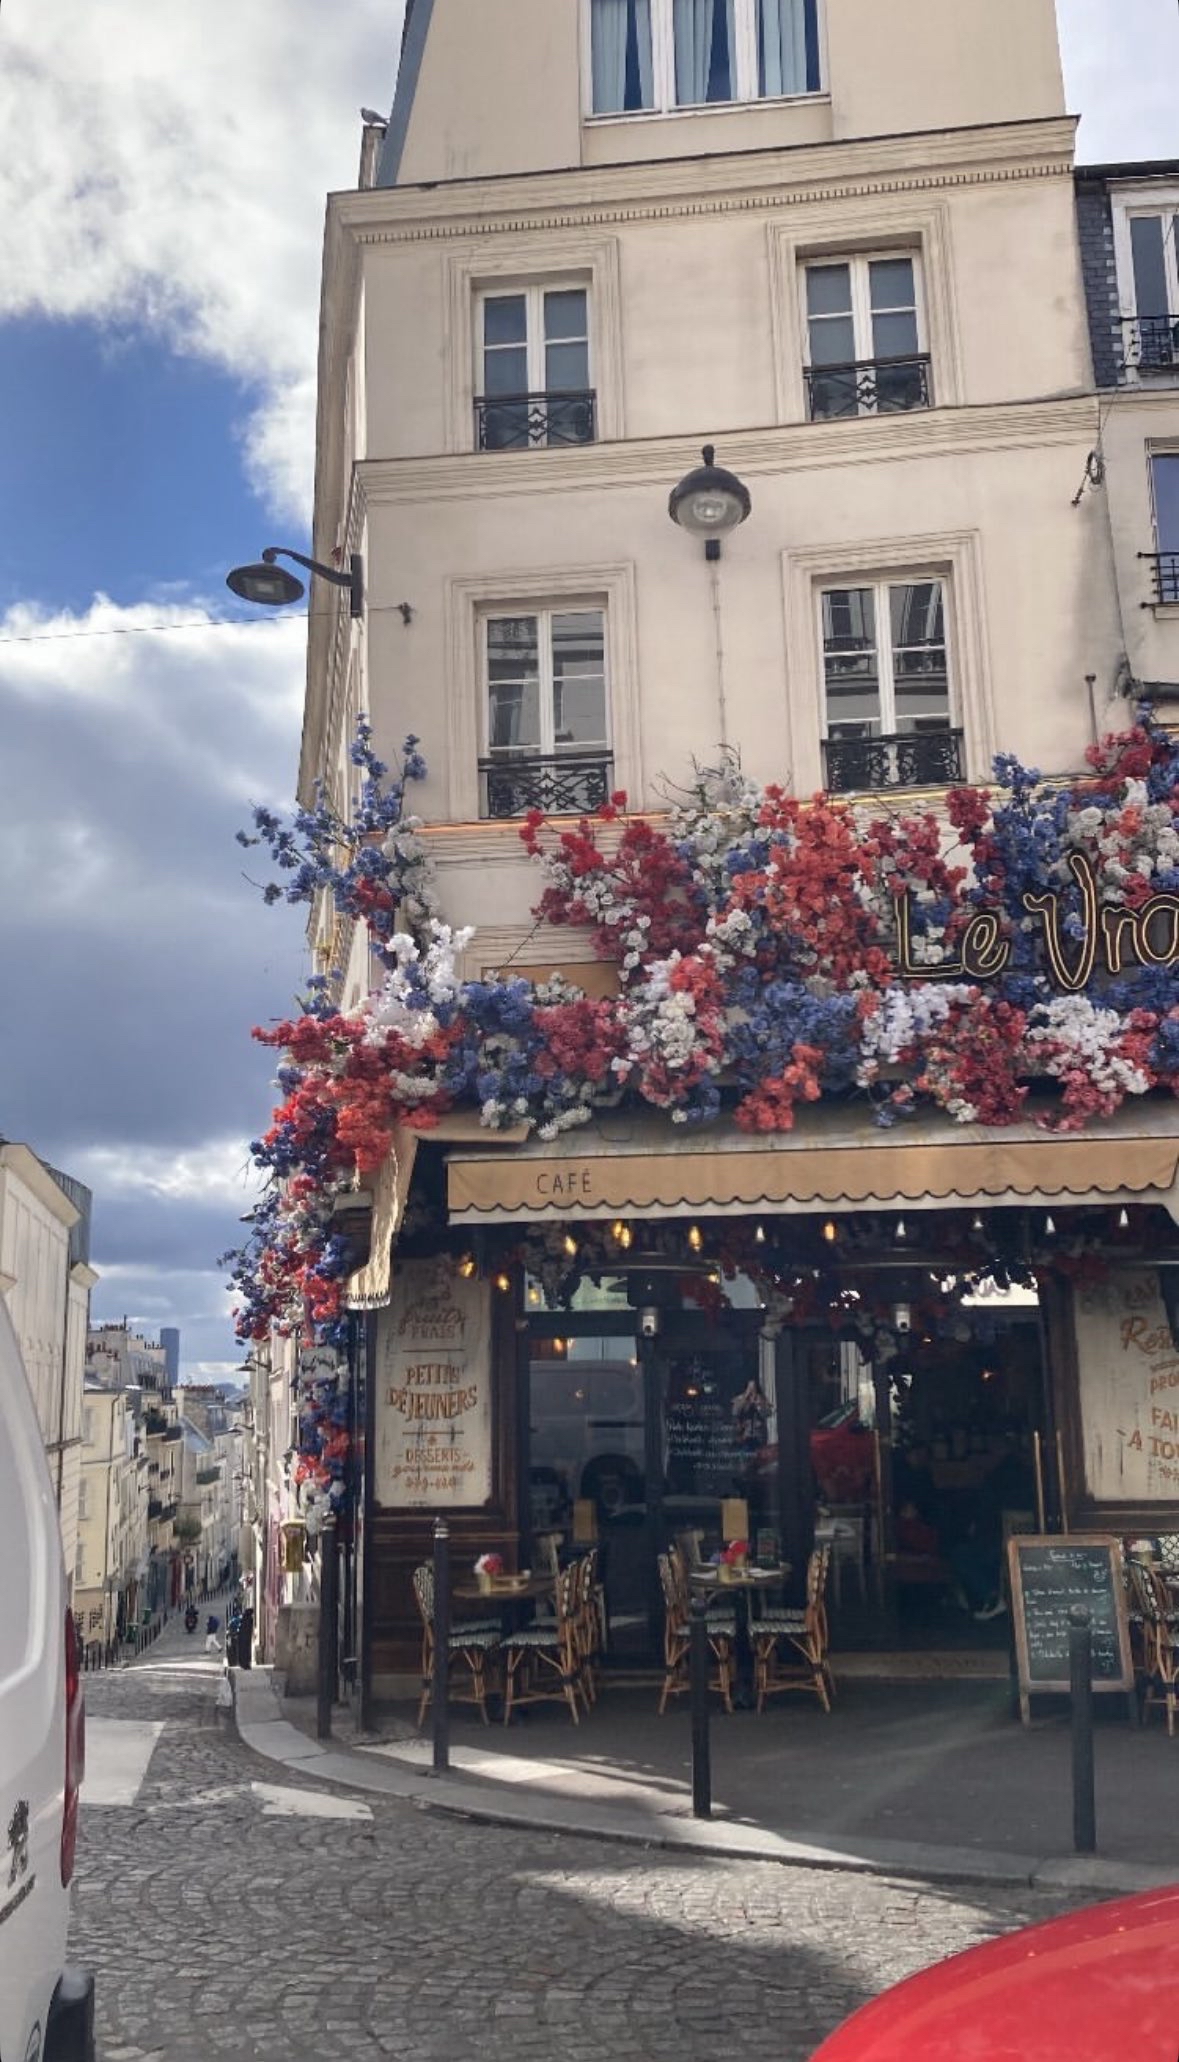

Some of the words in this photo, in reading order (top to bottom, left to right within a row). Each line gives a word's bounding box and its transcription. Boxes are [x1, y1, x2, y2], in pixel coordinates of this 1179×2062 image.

[893, 883, 1010, 979] Le
[536, 1167, 593, 1195] CAFÉ
[405, 1447, 461, 1463] DESSERTS
[1147, 1435, 1179, 1460] TO
